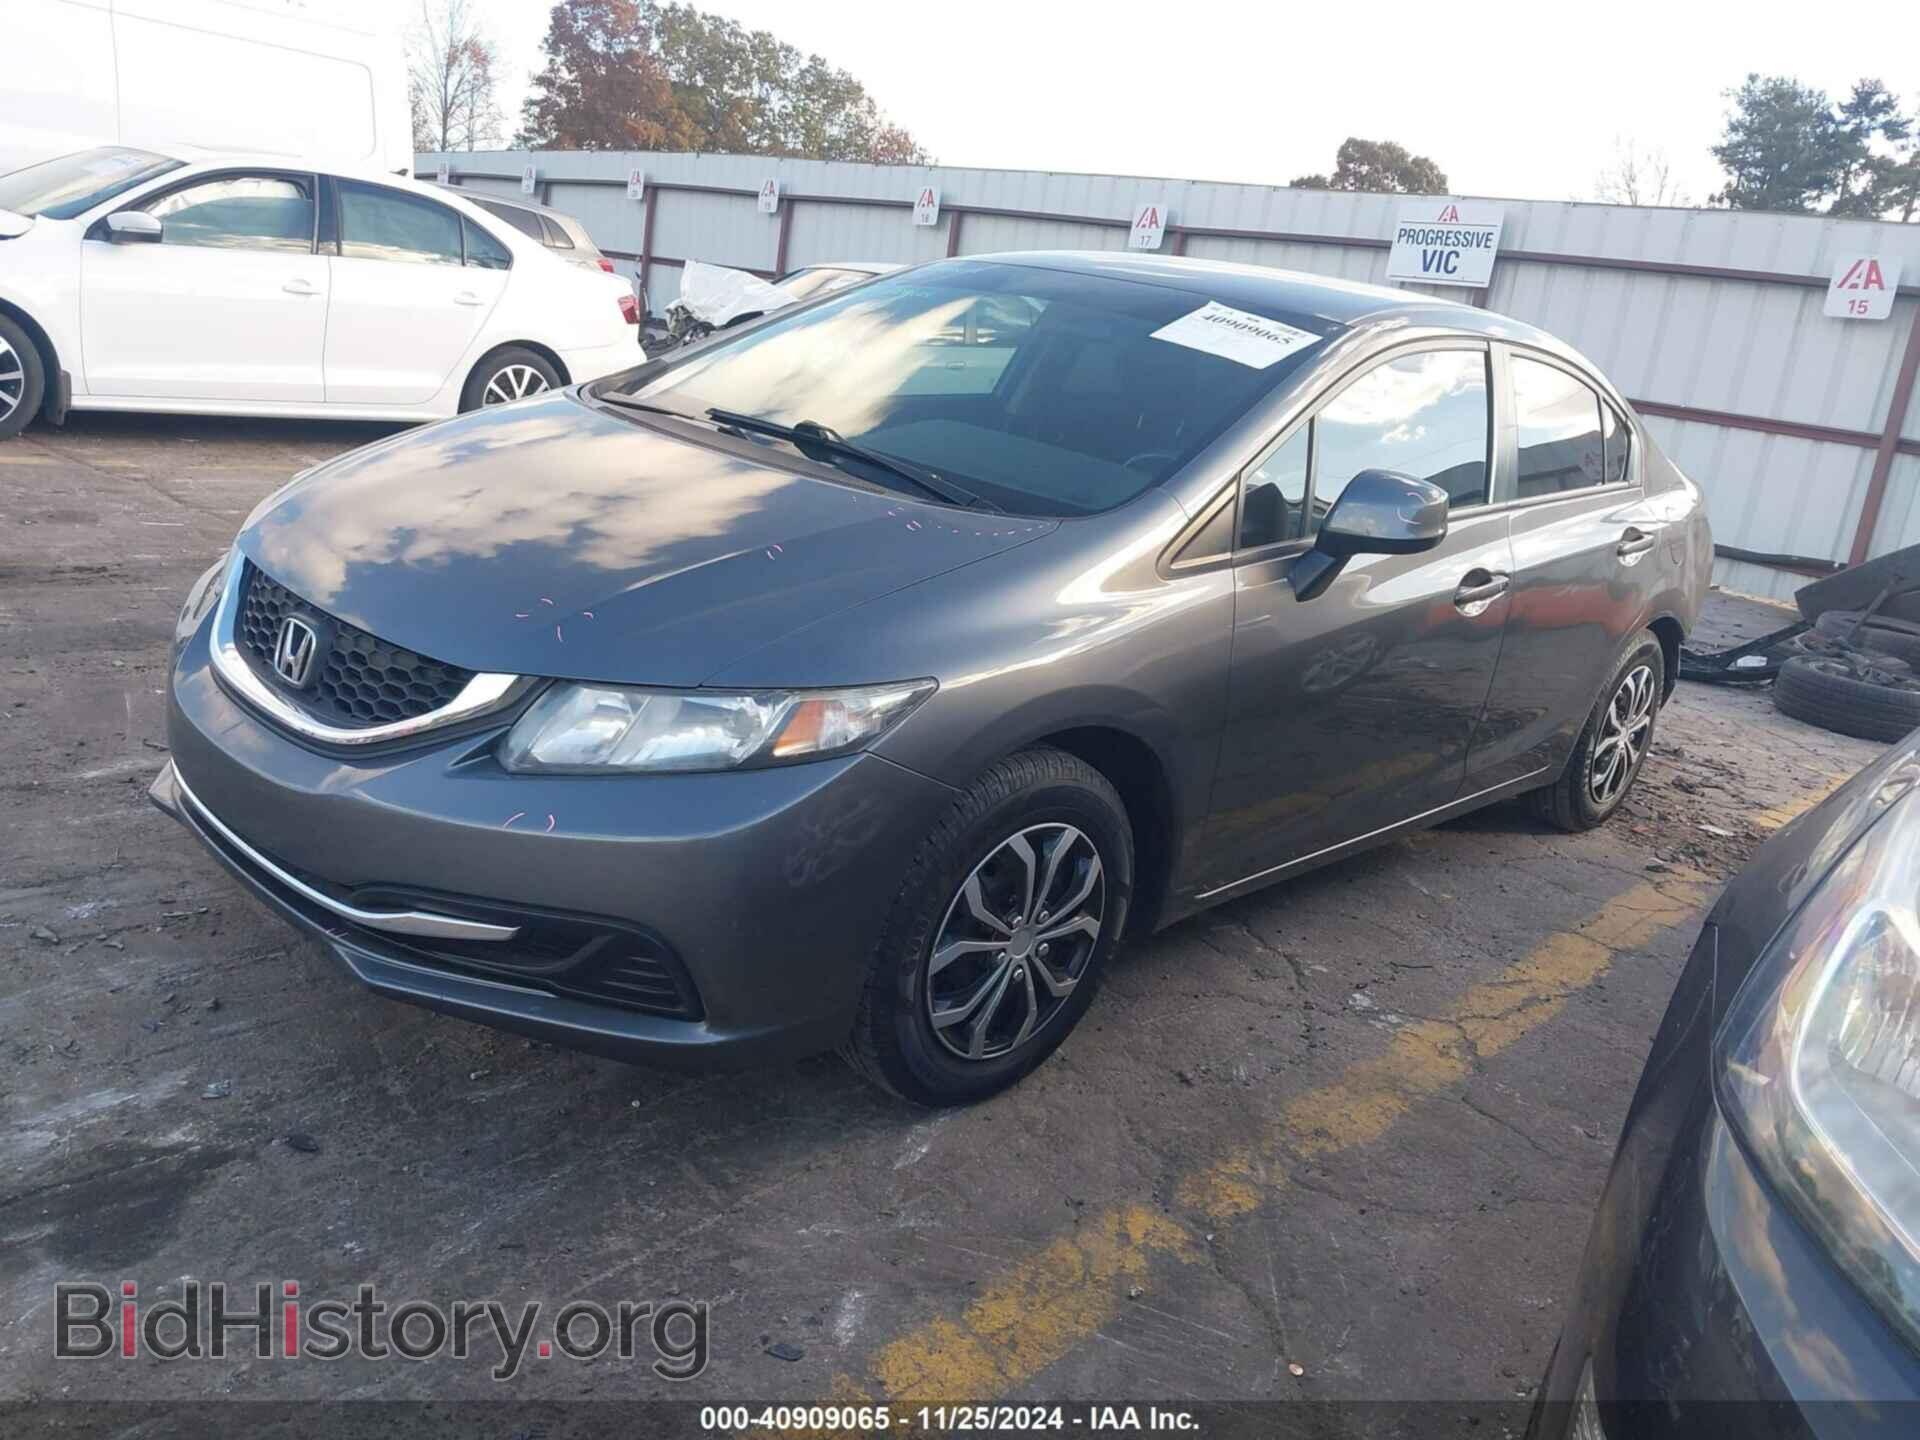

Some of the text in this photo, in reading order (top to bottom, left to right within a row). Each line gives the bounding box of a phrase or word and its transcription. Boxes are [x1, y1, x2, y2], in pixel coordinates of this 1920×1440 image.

[1140, 234, 1153, 247] 17
[1397, 228, 1494, 249] PROGRESSIVE
[1421, 249, 1460, 274] VIC
[1848, 299, 1870, 315] 15
